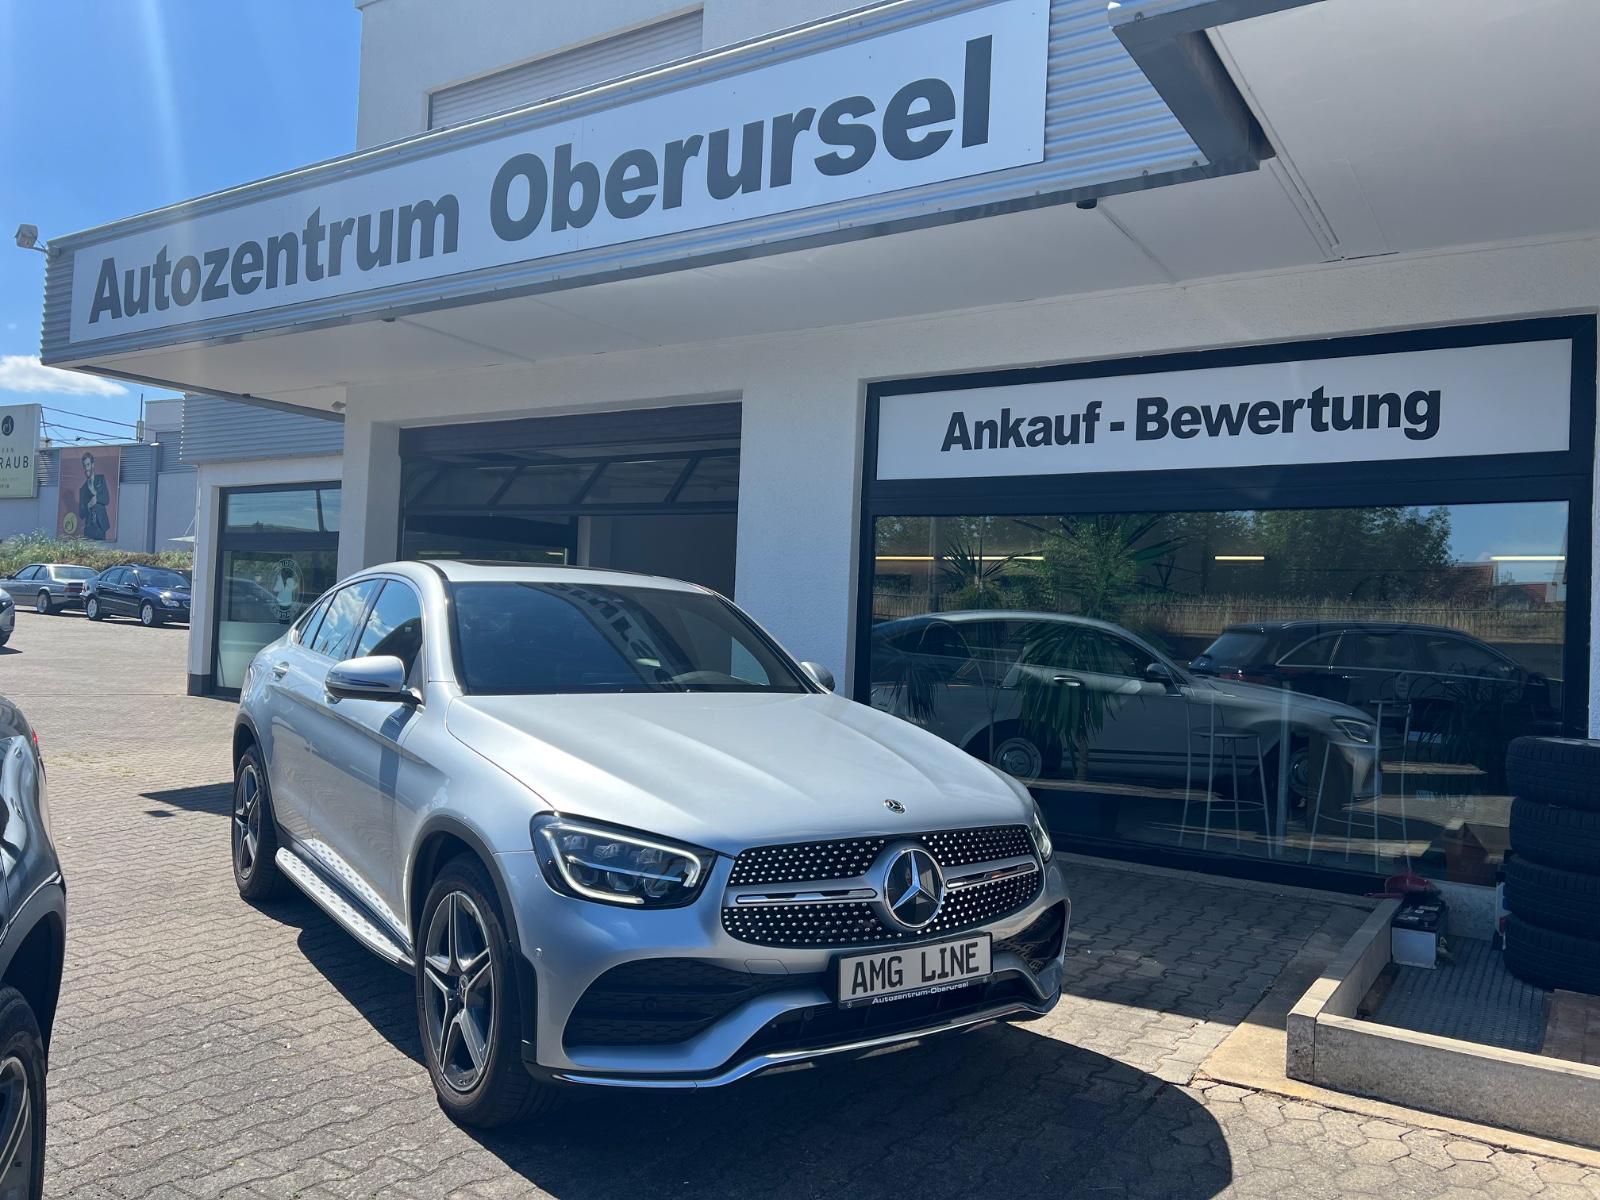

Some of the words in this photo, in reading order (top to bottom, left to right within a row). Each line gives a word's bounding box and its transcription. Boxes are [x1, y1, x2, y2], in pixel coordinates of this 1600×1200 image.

[88, 195, 460, 325] Autozentrum
[490, 35, 992, 242] Oberursel
[941, 400, 1103, 452] Ankauf
[1136, 386, 1441, 441] Bewertung
[851, 955, 904, 996] AMG
[921, 942, 979, 983] LINE
[872, 981, 969, 1005] Autozentrum-Oberursel
